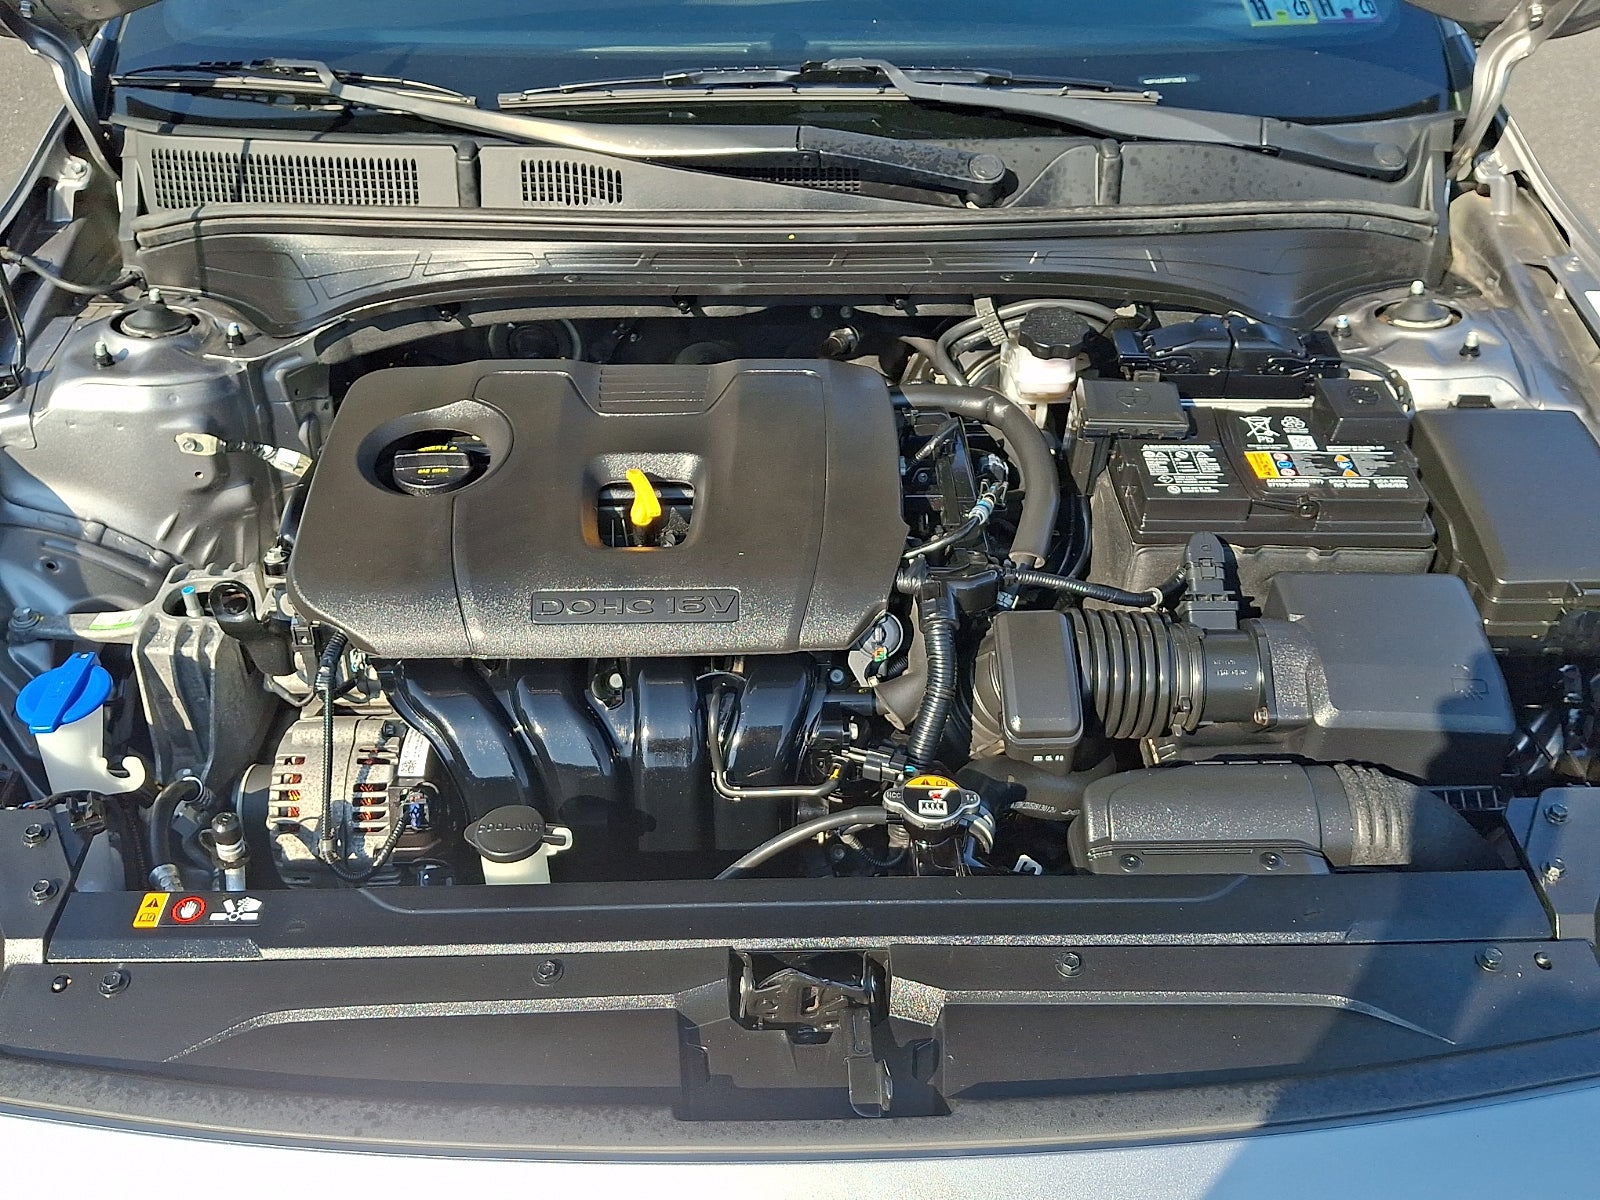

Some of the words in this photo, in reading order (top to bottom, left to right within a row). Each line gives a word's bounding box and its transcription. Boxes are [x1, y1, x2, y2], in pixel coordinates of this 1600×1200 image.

[1256, 435, 1275, 444] Pb
[536, 597, 655, 616] DOHC
[666, 595, 737, 614] 16V
[477, 822, 543, 834] COOLANT
